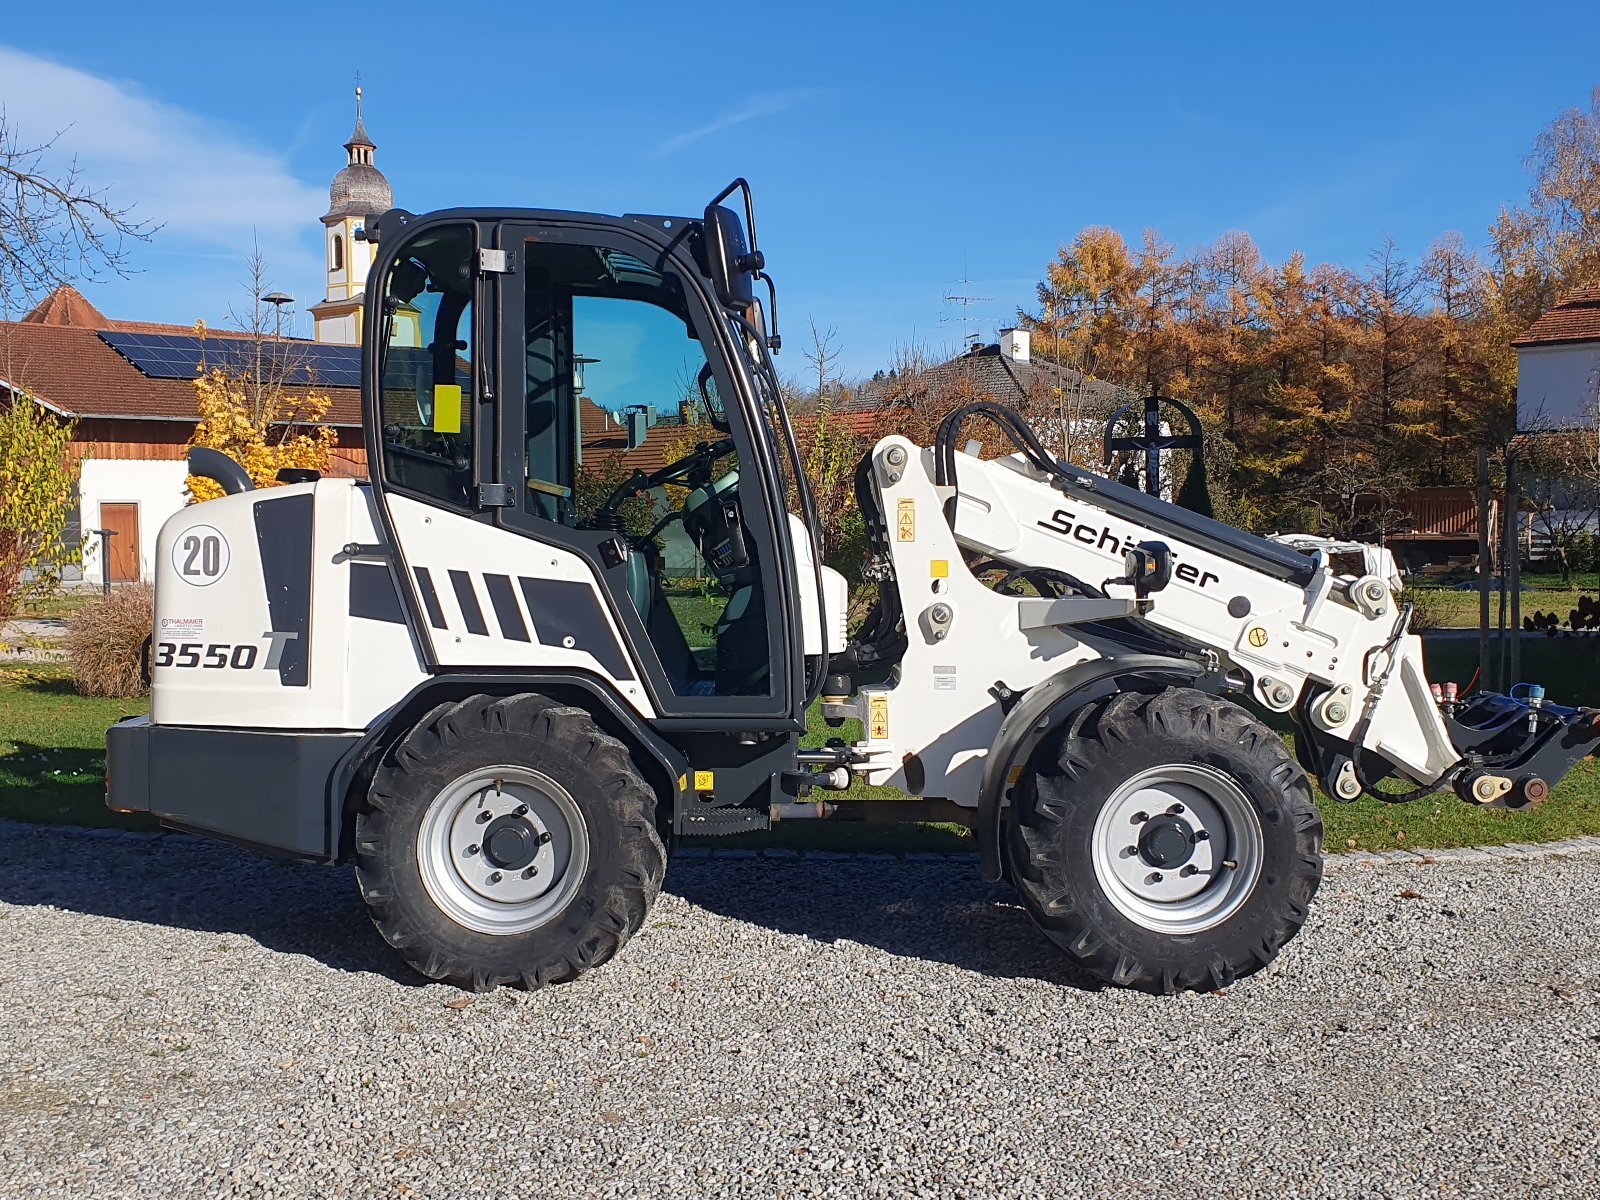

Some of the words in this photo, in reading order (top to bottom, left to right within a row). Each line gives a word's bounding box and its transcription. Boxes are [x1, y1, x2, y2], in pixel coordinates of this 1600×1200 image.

[183, 536, 220, 576] 20
[1038, 509, 1219, 587] Scher
[155, 643, 257, 669] 3550
